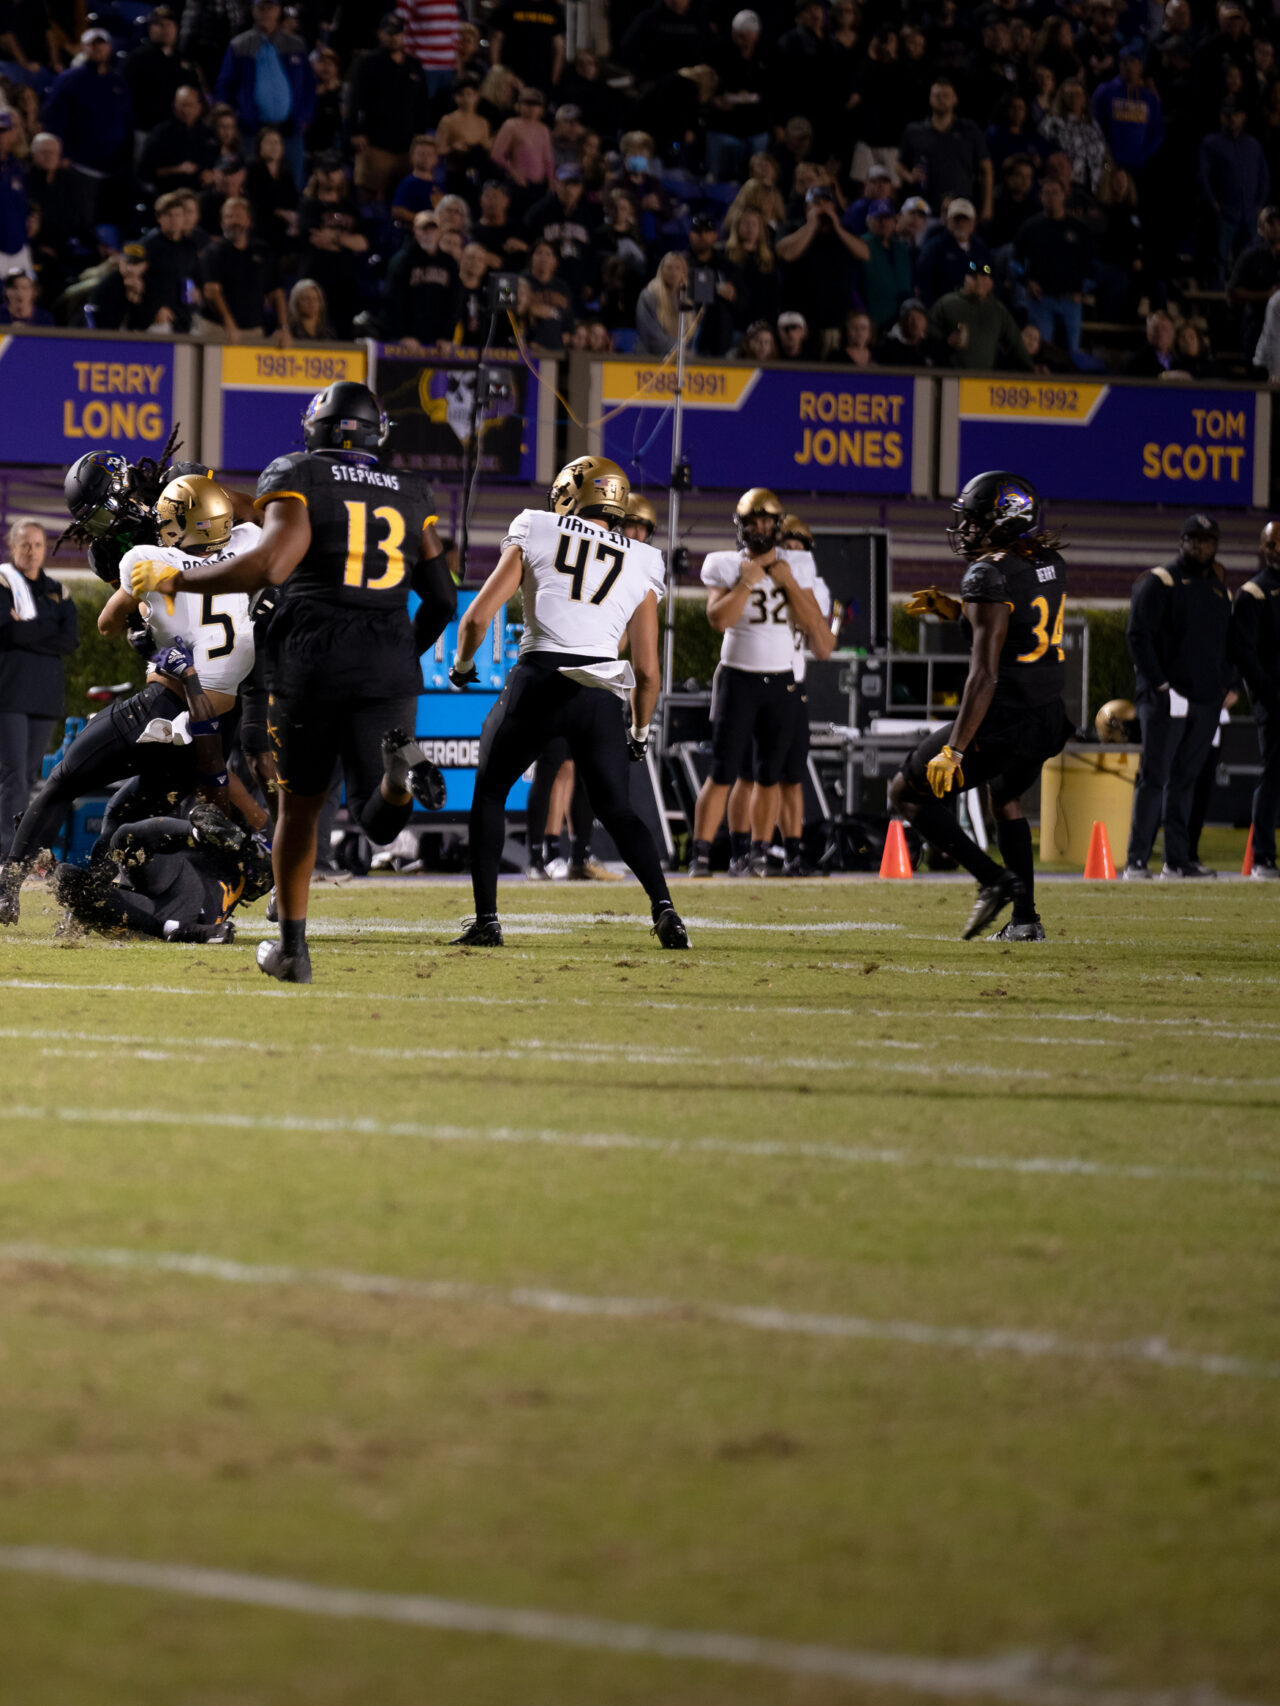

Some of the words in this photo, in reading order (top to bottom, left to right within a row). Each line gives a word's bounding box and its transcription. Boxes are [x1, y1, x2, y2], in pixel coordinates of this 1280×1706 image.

[73, 360, 165, 395] TERRY
[255, 353, 347, 380] 1981-1982
[799, 390, 904, 425] ROBERT
[989, 386, 1078, 410] 1989-1992
[63, 399, 164, 441] LONG
[1192, 408, 1245, 439] TOM
[793, 428, 903, 468] JONES
[1142, 441, 1245, 482] SCOTT
[331, 464, 400, 491] STEPHENS
[342, 500, 407, 590] 13
[553, 533, 625, 605] 47
[748, 588, 788, 625] 32
[200, 592, 236, 660] 5
[1016, 592, 1067, 663] 34
[420, 739, 480, 766] ERADE
